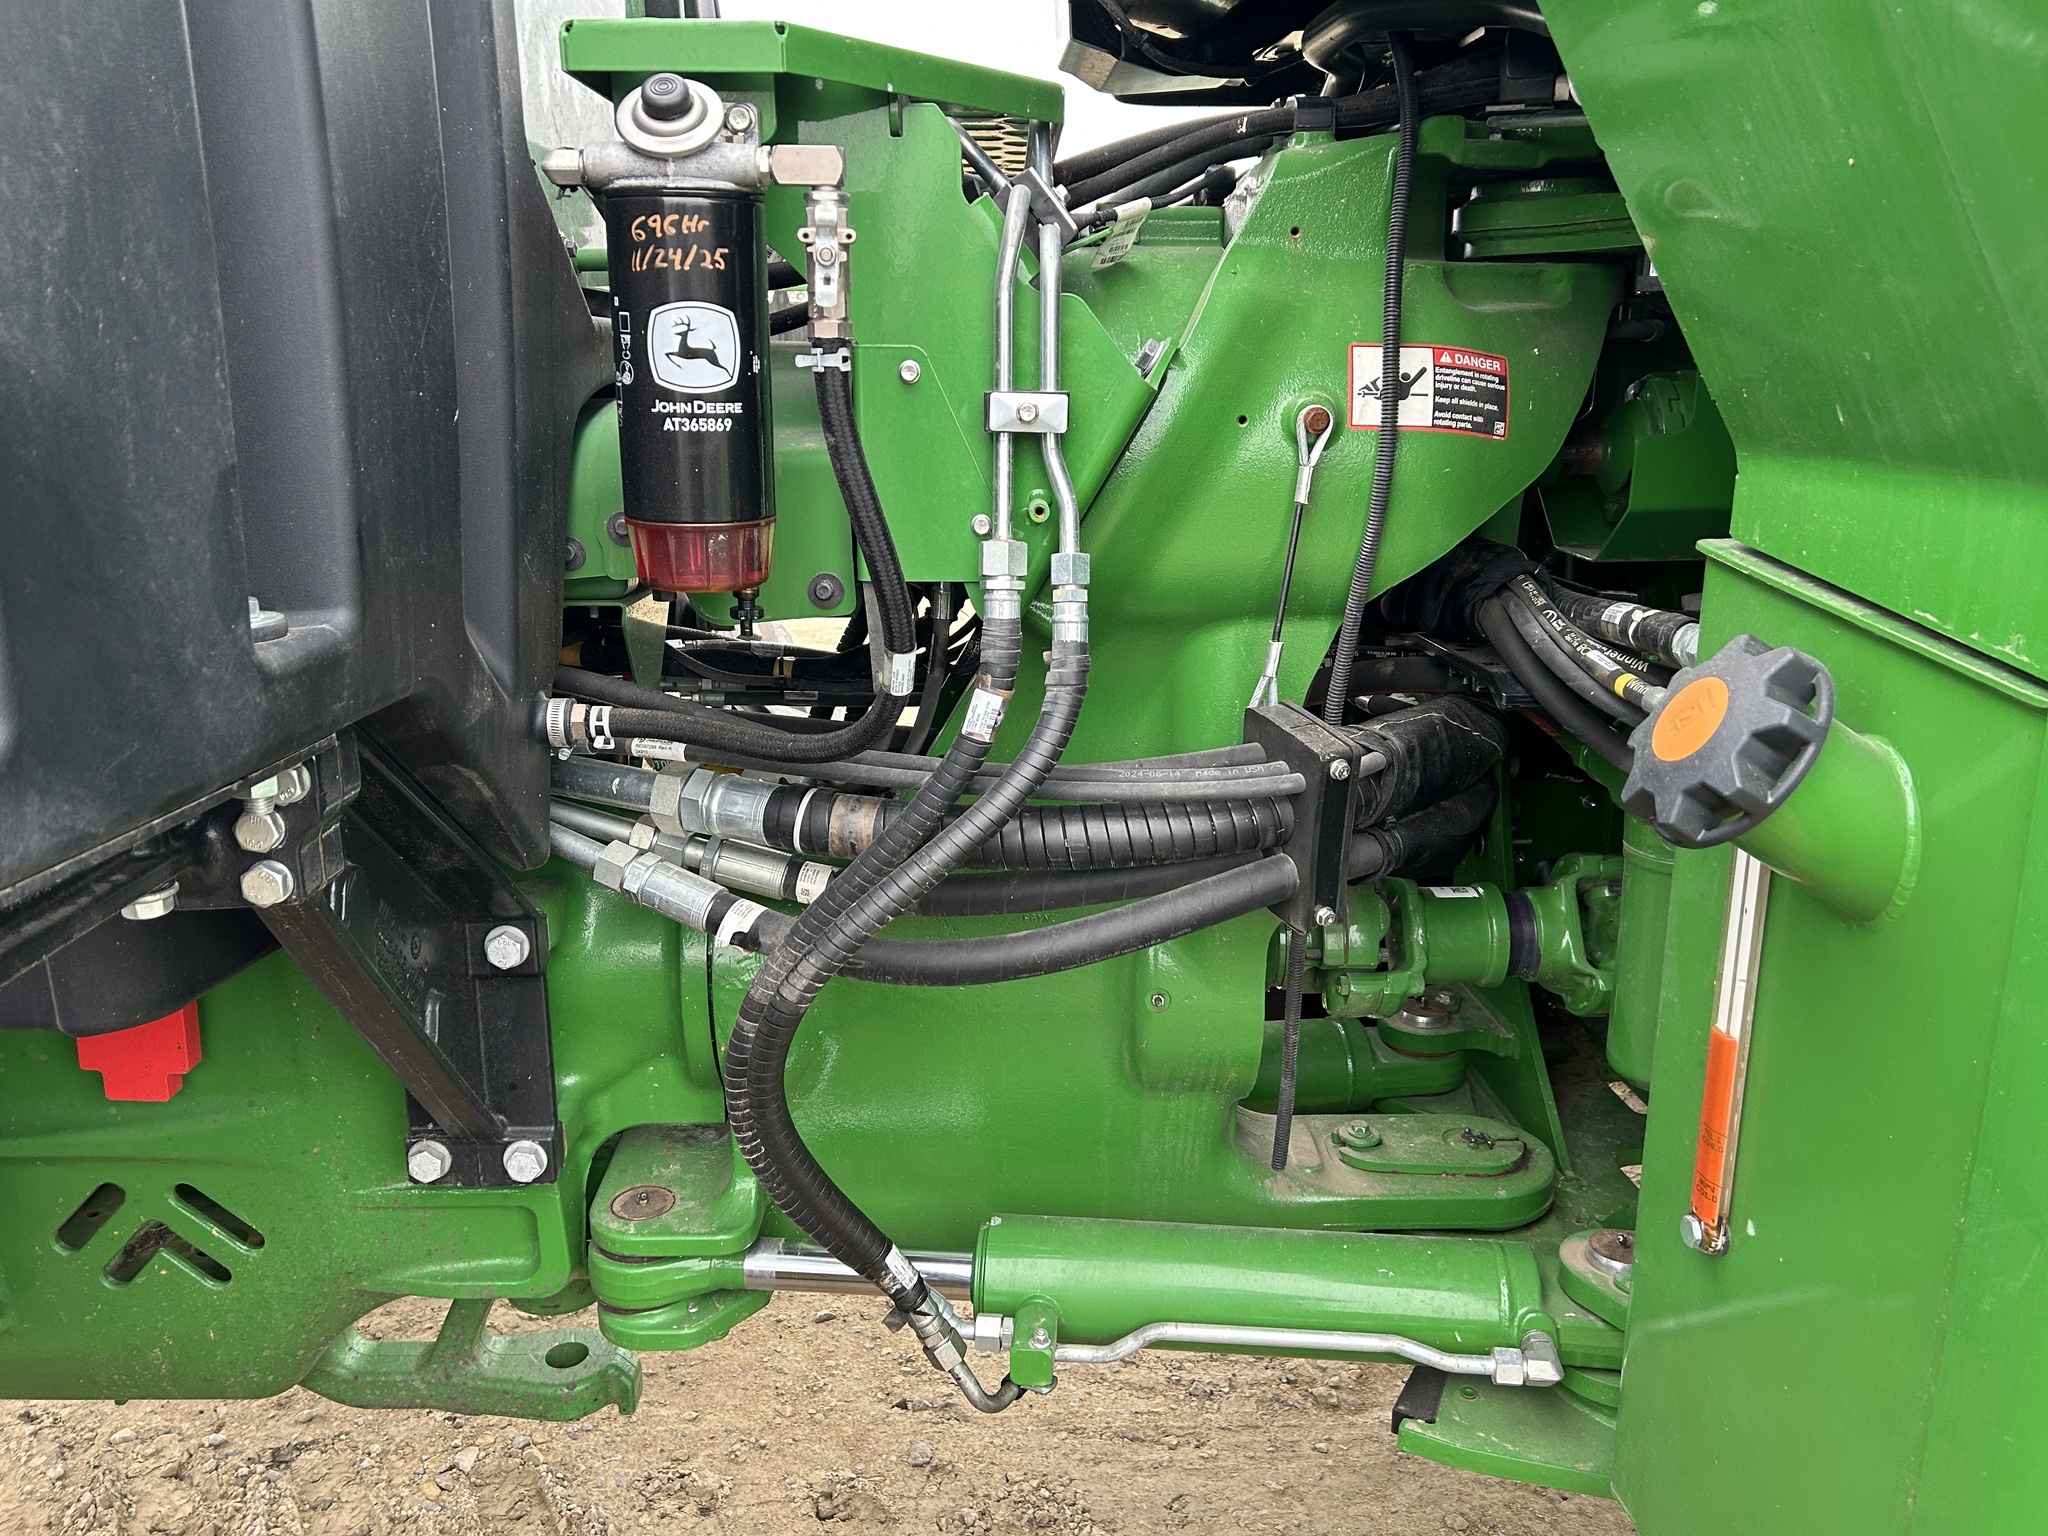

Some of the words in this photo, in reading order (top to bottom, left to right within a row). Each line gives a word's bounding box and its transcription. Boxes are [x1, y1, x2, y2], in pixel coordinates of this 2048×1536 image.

[631, 243, 730, 272] 11/24/25
[1454, 353, 1501, 372] DANGER
[1435, 366, 1474, 377] Entanglement
[1474, 371, 1480, 379] in
[1480, 373, 1500, 384] rotating
[1435, 374, 1460, 383] driveline
[1461, 377, 1472, 385] can
[1471, 379, 1487, 388] cause
[1487, 382, 1506, 391] serious
[1460, 384, 1477, 393] death.
[1434, 395, 1451, 405] Keep
[1451, 397, 1459, 405] all
[1459, 398, 1479, 408] shields
[1478, 400, 1484, 408] in
[1484, 402, 1499, 411] place.
[663, 416, 733, 432] AT365869
[1433, 410, 1452, 419] Avoid
[1451, 413, 1473, 421] contact
[1472, 415, 1484, 423] with
[1433, 419, 1457, 429] rotating
[1456, 421, 1473, 429] parts.
[1603, 648, 1650, 673] Winner
[1118, 770, 1181, 779] 2024-06-14
[1195, 769, 1221, 778] Made
[1245, 765, 1265, 774] USA
[1696, 1183, 1718, 1204] COLD
